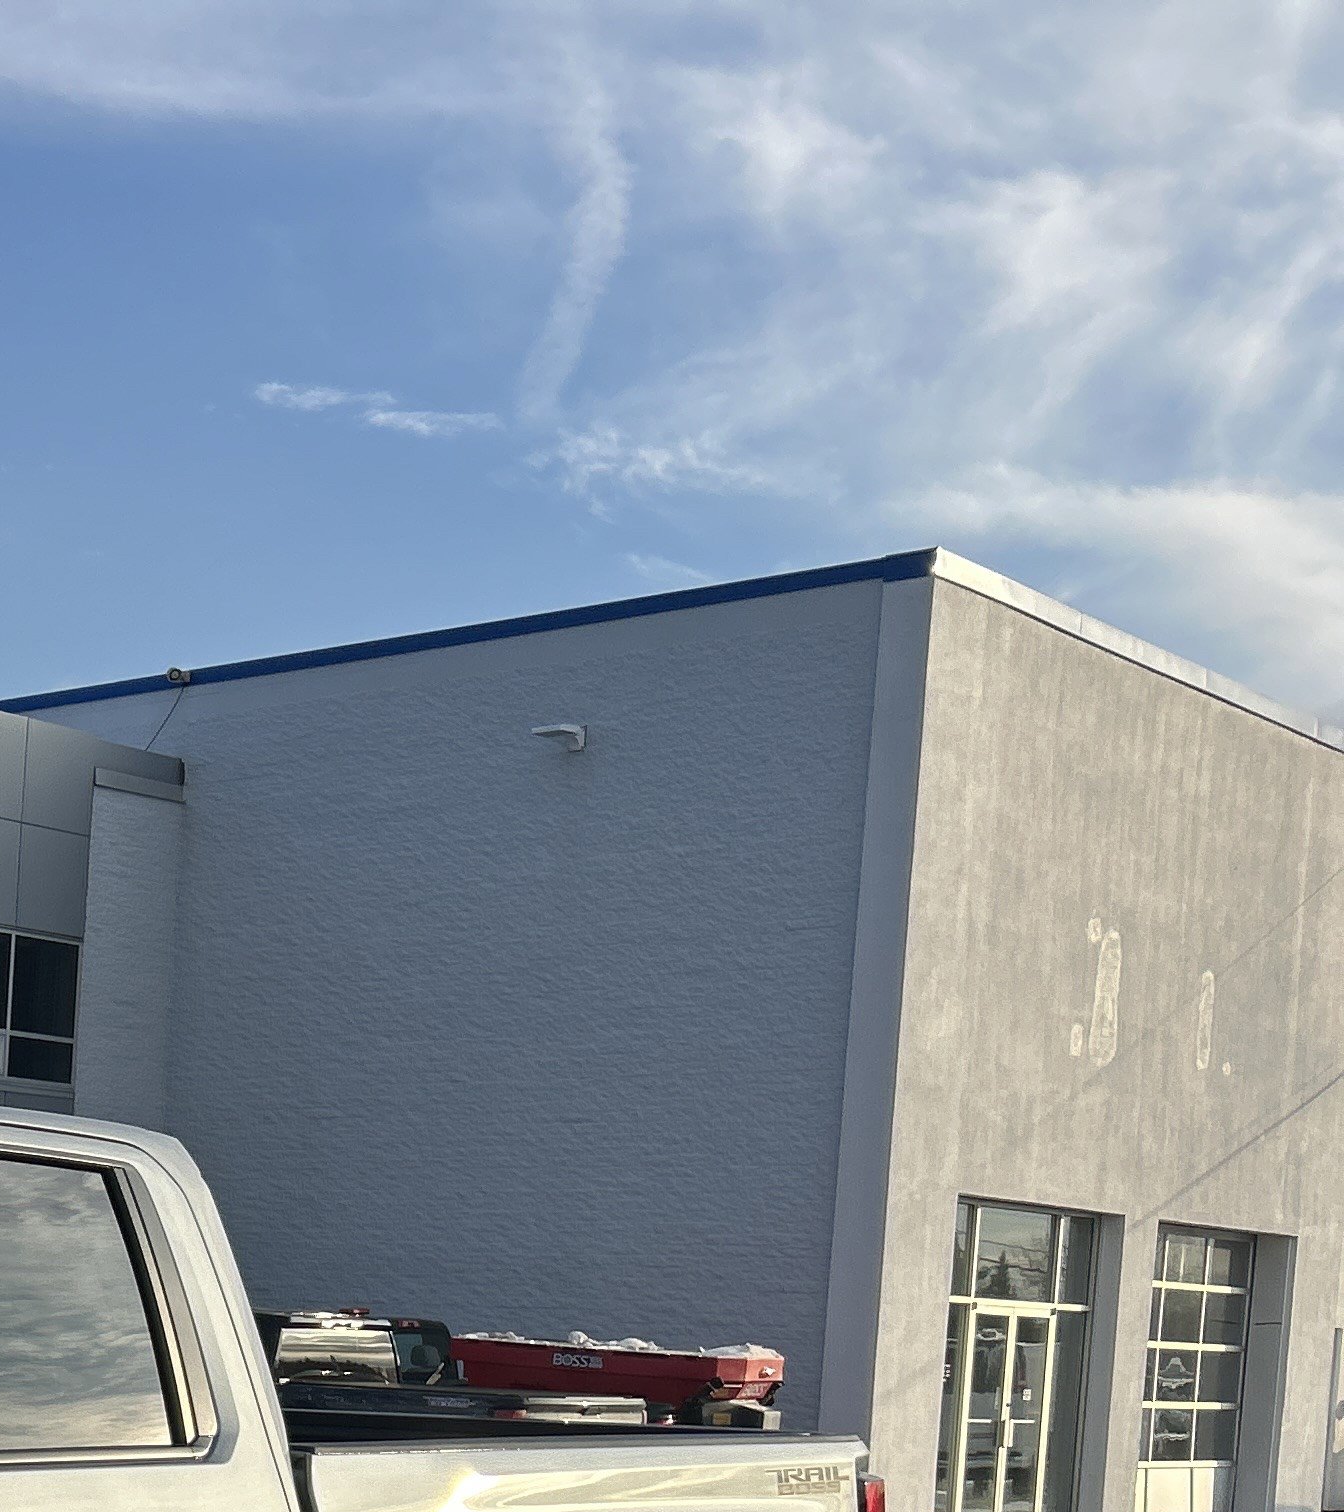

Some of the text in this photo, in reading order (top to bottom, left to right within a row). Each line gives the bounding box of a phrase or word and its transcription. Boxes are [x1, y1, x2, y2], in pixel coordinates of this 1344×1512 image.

[553, 1353, 589, 1368] BOSS
[765, 1466, 849, 1484] TRAIL
[777, 1480, 841, 1496] BOSS
